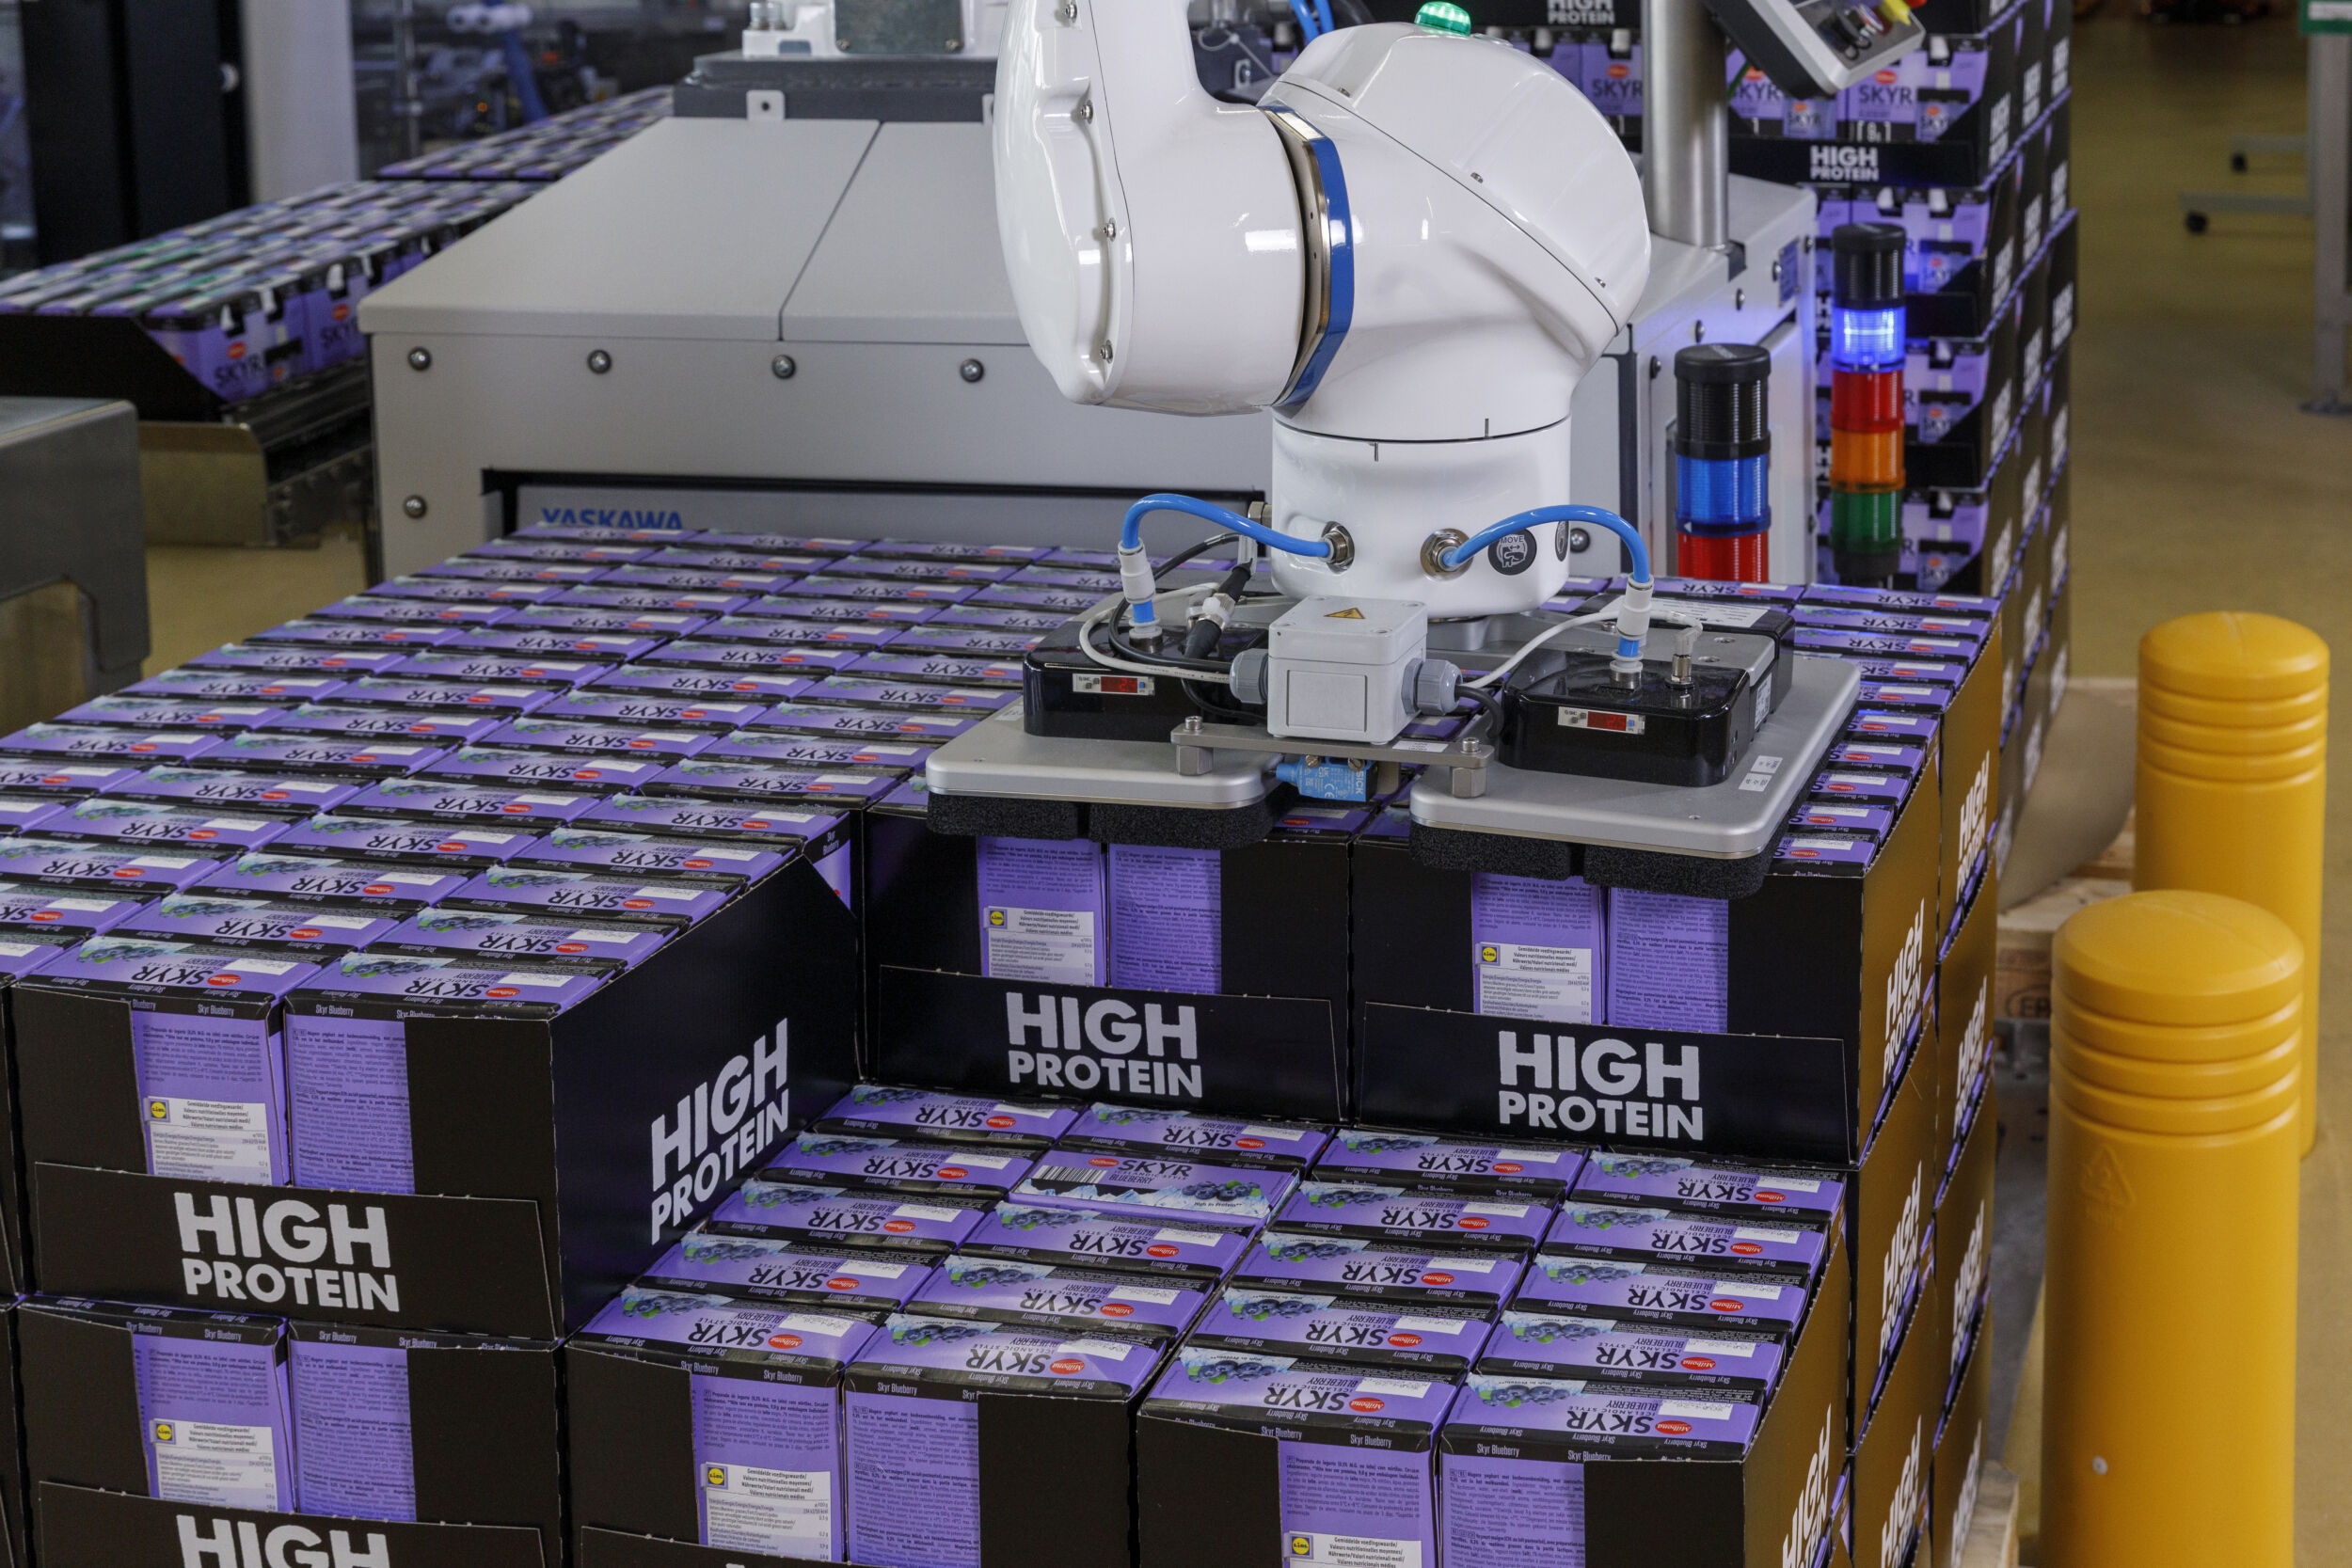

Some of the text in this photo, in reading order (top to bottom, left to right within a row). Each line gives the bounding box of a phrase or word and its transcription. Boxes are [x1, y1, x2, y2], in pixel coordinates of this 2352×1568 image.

[1548, 10, 1615, 24] PROTEIN
[1592, 79, 1643, 98] SKYR
[1858, 86, 1913, 105] SKYR
[1810, 145, 1879, 167] HIGH
[1810, 166, 1879, 182] PROTEIN
[541, 507, 683, 530] YASKAWA
[966, 638, 1022, 649] SKYR
[462, 664, 523, 675] SKYR
[922, 663, 982, 675] SKYR
[881, 690, 943, 703] SKYR
[619, 705, 683, 718] SKYR
[835, 719, 899, 731] SKYR
[565, 735, 631, 747] SKYR
[286, 751, 353, 761] SKYR
[787, 749, 853, 761] SKYR
[509, 765, 576, 778] SKYR
[739, 779, 807, 791] SKYR
[1356, 770, 1364, 795] SICK
[196, 785, 264, 799] SKYR
[435, 799, 506, 812] SKYR
[1959, 750, 1990, 862] HIGH
[672, 814, 743, 828] SKYR
[121, 823, 192, 838] SKYR
[367, 836, 439, 850] SKYR
[611, 852, 686, 867] SKYR
[43, 862, 117, 877] SKYR
[291, 879, 366, 894] SKYR
[548, 892, 626, 908] SKYR
[215, 921, 293, 938] SKYR
[479, 935, 559, 952] SKYR
[132, 966, 211, 985] SKYR
[1884, 897, 1925, 1040] HIGH
[405, 981, 489, 997] SKYR
[198, 1004, 234, 1017] Skyr Blueberry
[315, 1004, 354, 1018] Skyr Blueberry
[1006, 991, 1198, 1059] HIGH
[1883, 961, 1921, 1087] PROTEIN
[1956, 974, 1987, 1099] HIGH
[1499, 1030, 1699, 1101] HIGH
[1008, 1050, 1202, 1098] PROTEIN
[651, 1017, 787, 1192] HIGH
[915, 1107, 987, 1127] SKYR
[1499, 1090, 1703, 1140] PROTEIN
[1163, 1129, 1236, 1148] SKYR
[651, 1088, 789, 1245] PROTEIN
[864, 1159, 939, 1178] SKYR
[1118, 1160, 1192, 1177] SKYR
[1419, 1156, 1492, 1172] SKYR
[1108, 1173, 1155, 1184] BLUEBERRY
[1678, 1181, 1752, 1201] SKYR
[1755, 1193, 1785, 1201] Milbona
[808, 1212, 885, 1230] SKYR
[1381, 1210, 1457, 1228] SKYR
[174, 1192, 391, 1269] HIGH
[1070, 1234, 1148, 1256] SKYR
[1652, 1233, 1729, 1253] SKYR
[1732, 1243, 1762, 1253] Milbona
[1882, 1160, 1922, 1320] HIGH
[749, 1268, 829, 1289] SKYR
[1343, 1265, 1421, 1284] SKYR
[1422, 1274, 1454, 1284] Milbona
[182, 1259, 400, 1312] PROTEIN
[1020, 1292, 1102, 1315] SKYR
[1628, 1289, 1708, 1310] SKYR
[1711, 1301, 1743, 1310] Milbona
[204, 1329, 242, 1342] Skyr Blueberry
[319, 1331, 357, 1344] Skyr Blueberry
[689, 1323, 771, 1347] SKYR
[770, 1336, 802, 1348] Milbona
[1306, 1324, 1389, 1346] SKYR
[1389, 1335, 1422, 1346] Milbona
[1635, 1338, 1684, 1348] BLUEBERRY
[966, 1349, 1051, 1373] SKYR
[1051, 1360, 1084, 1373] Milbona
[1596, 1347, 1679, 1370] SKYR
[1682, 1358, 1716, 1369] Milbona
[763, 1369, 803, 1384] Skyr Blueberry
[1307, 1377, 1359, 1387] BLUEBERRY
[878, 1383, 917, 1396] Skyr Blueberry
[962, 1389, 976, 1401] Skyr
[1264, 1387, 1349, 1411] SKYR
[1350, 1399, 1384, 1411] Milbona
[1606, 1400, 1658, 1411] BLUEBERRY
[1567, 1411, 1654, 1433] SKYR
[1657, 1422, 1692, 1433] Milbona
[1261, 1426, 1275, 1436] Skyr
[1350, 1433, 1392, 1449] Skyr Blueberry
[1477, 1444, 1519, 1458] Skyr Blueberry
[1567, 1449, 1581, 1460] Skyr
[1782, 1403, 1832, 1568] HIGH
[1881, 1415, 1922, 1568] HIGH
[176, 1514, 390, 1568] HIGH
